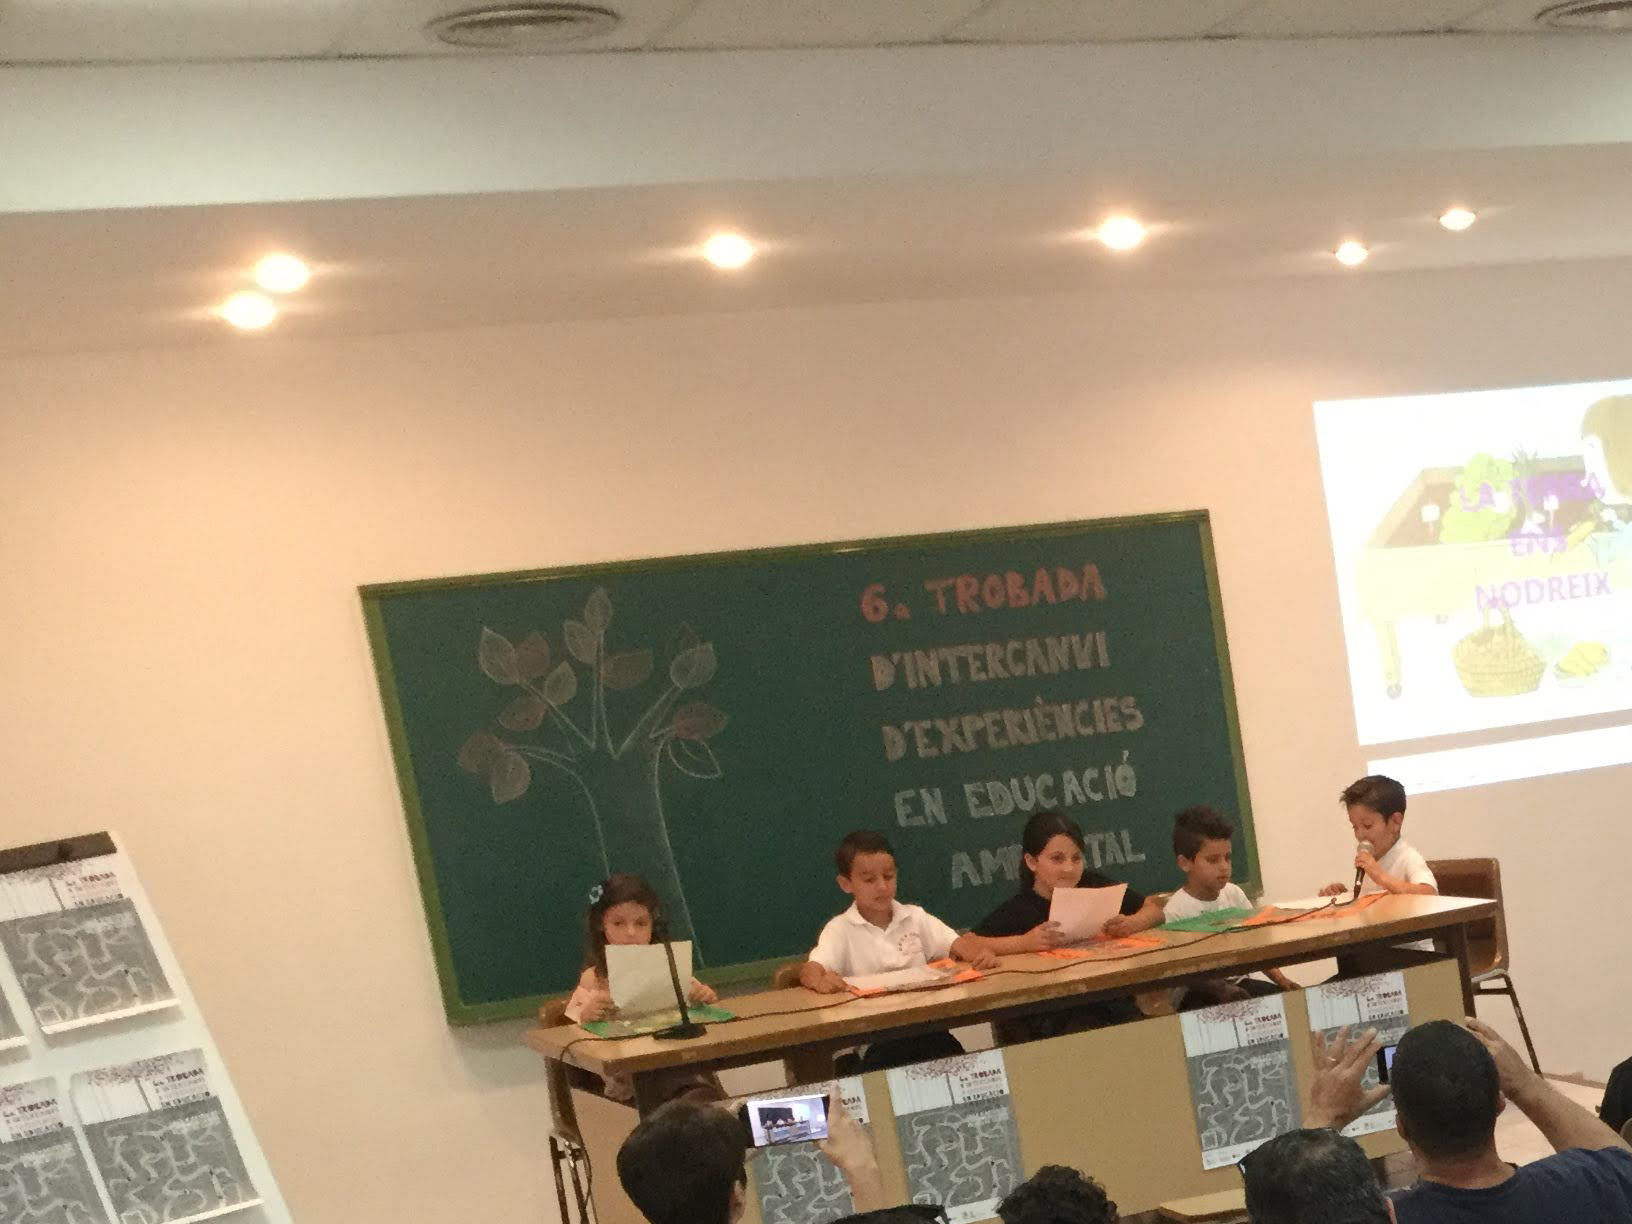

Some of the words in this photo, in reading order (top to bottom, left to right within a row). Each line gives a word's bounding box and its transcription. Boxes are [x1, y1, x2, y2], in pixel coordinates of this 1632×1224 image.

[860, 583, 911, 623] 6.
[923, 562, 1106, 615] TROBADA
[1474, 571, 1613, 613] NODREIX
[895, 786, 948, 827] EN
[963, 749, 1138, 819] EDUCACIÓ
